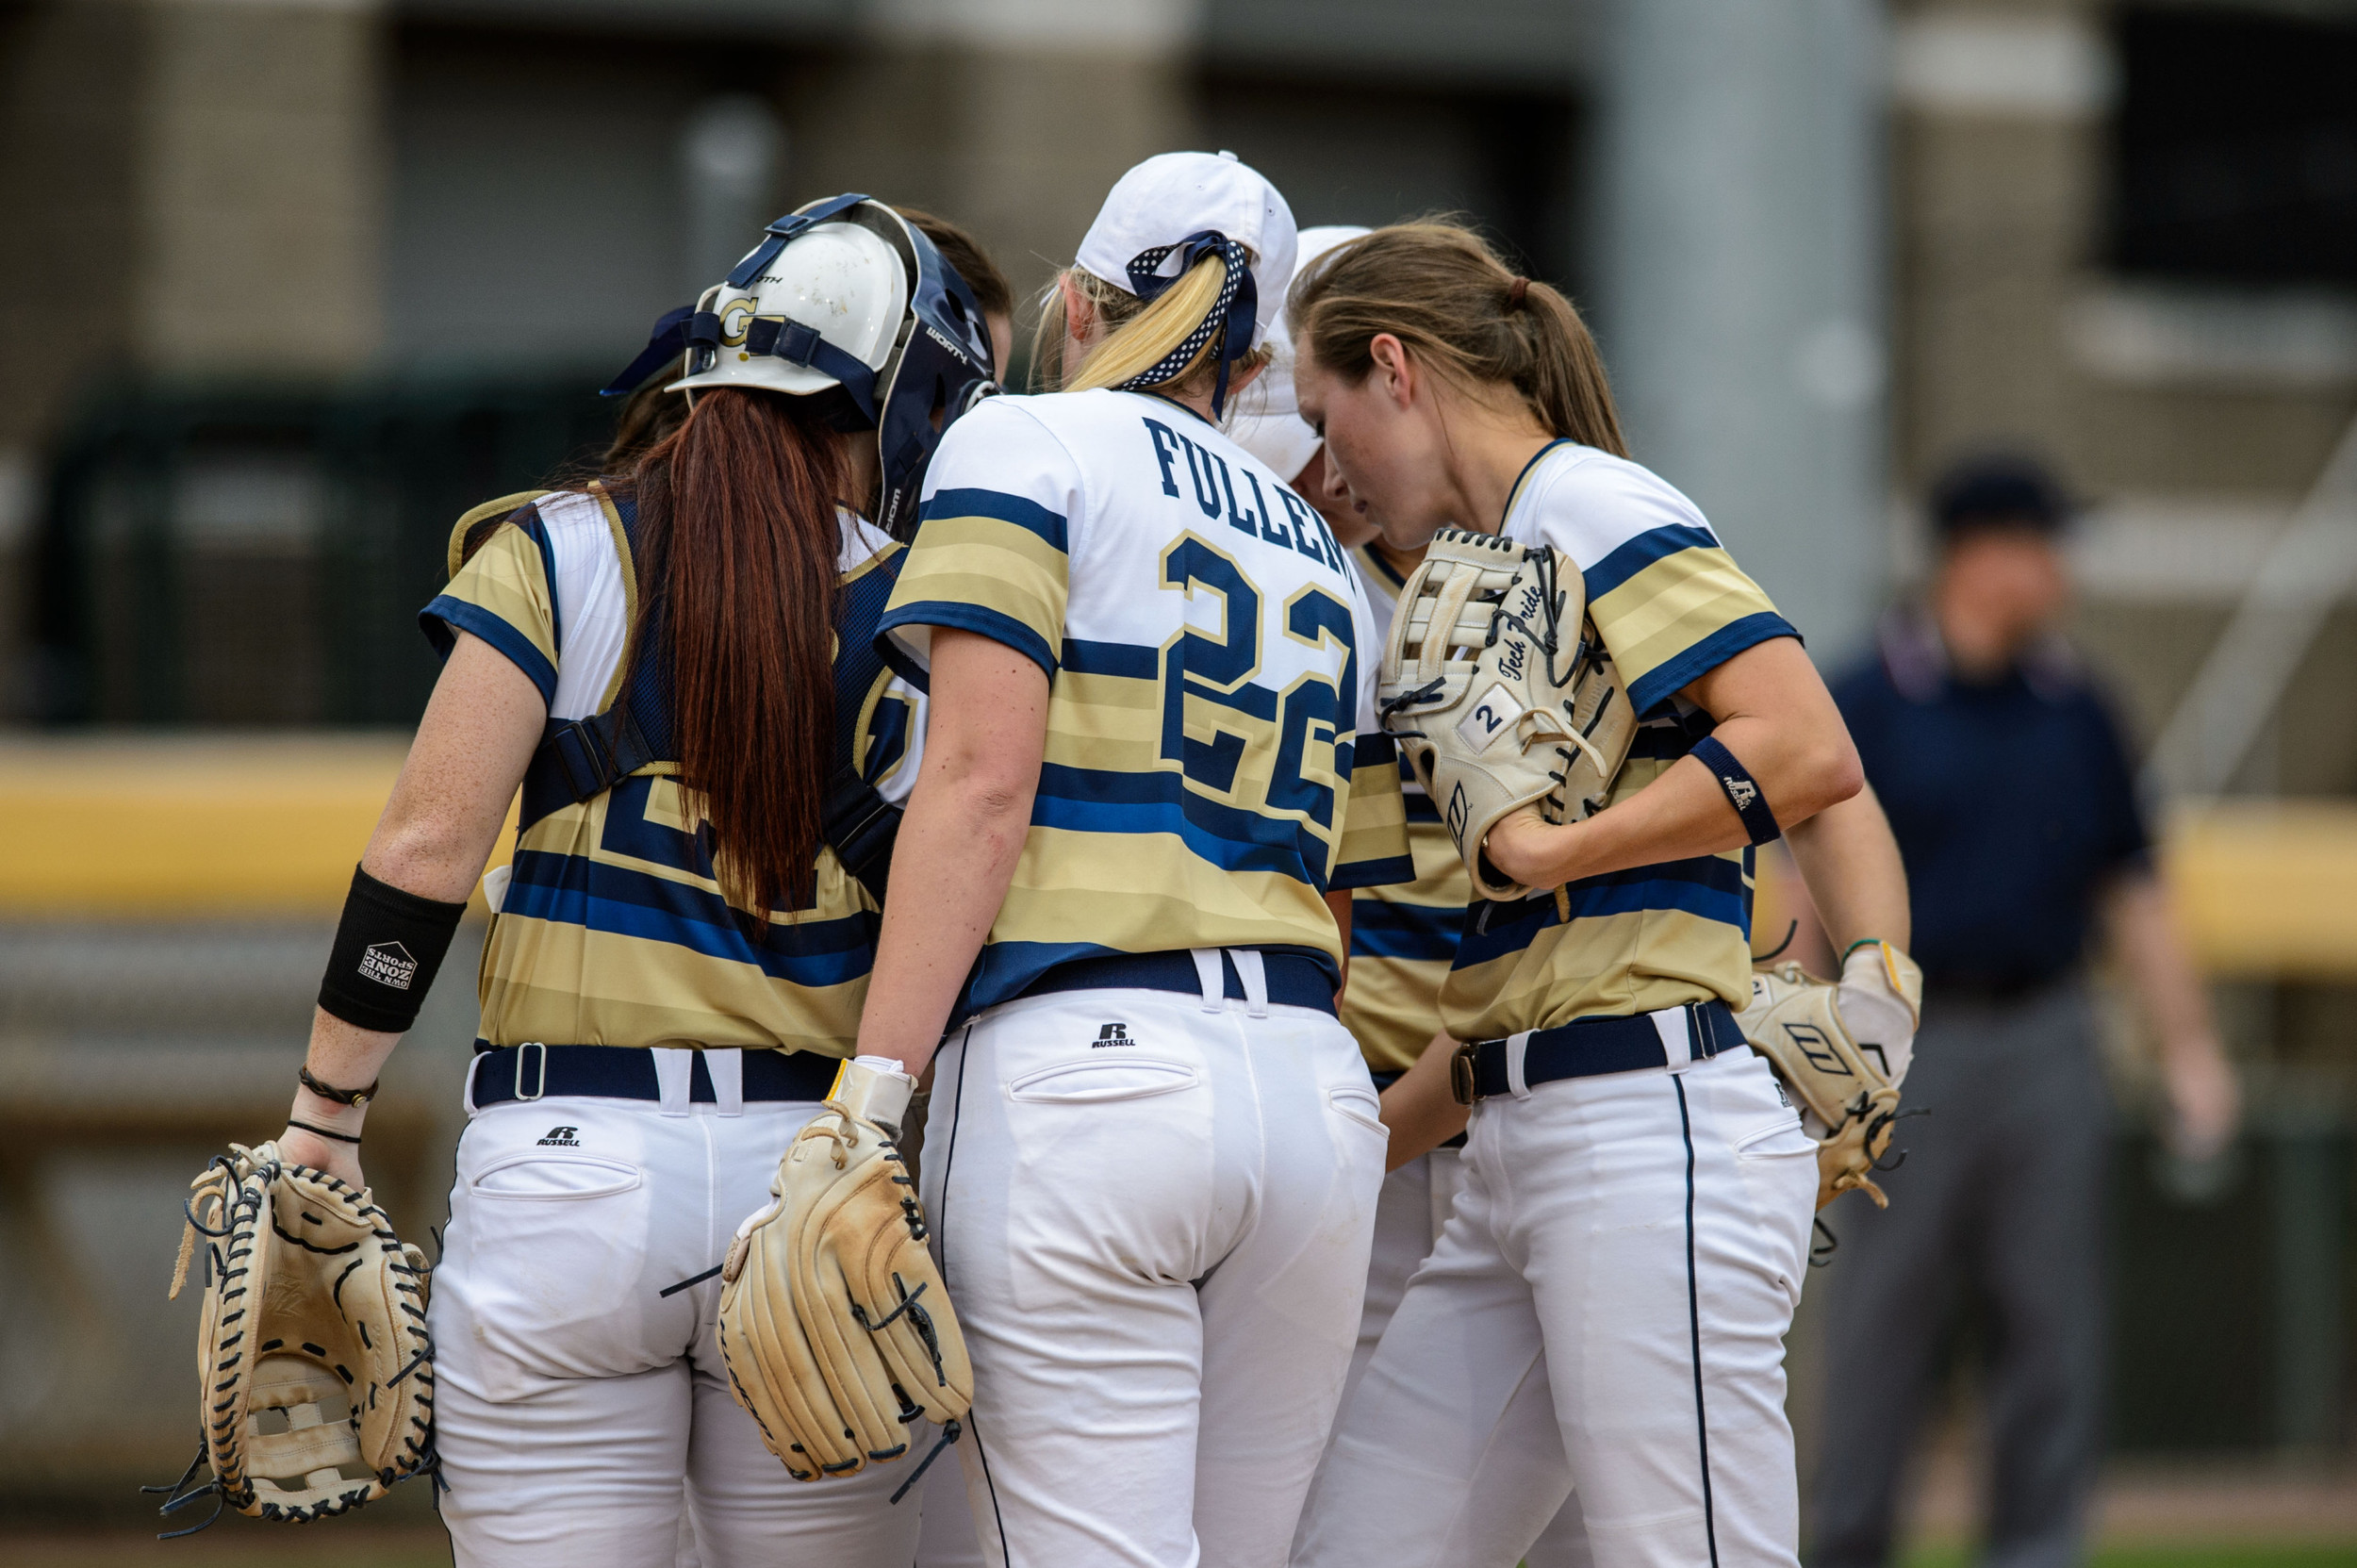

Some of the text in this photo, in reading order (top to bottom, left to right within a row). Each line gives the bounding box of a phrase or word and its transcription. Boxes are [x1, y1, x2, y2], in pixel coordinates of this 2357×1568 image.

[884, 487, 901, 536] WOR
[1498, 638, 1526, 681] Tech
[1153, 528, 1358, 846] 22
[1475, 705, 1504, 734] 2
[363, 955, 412, 981] ZONE
[368, 948, 415, 970] SPORTS
[360, 966, 408, 987] OWN THE
[1091, 1038, 1136, 1049] RUSSELL
[536, 1138, 581, 1147] RUSSELL
